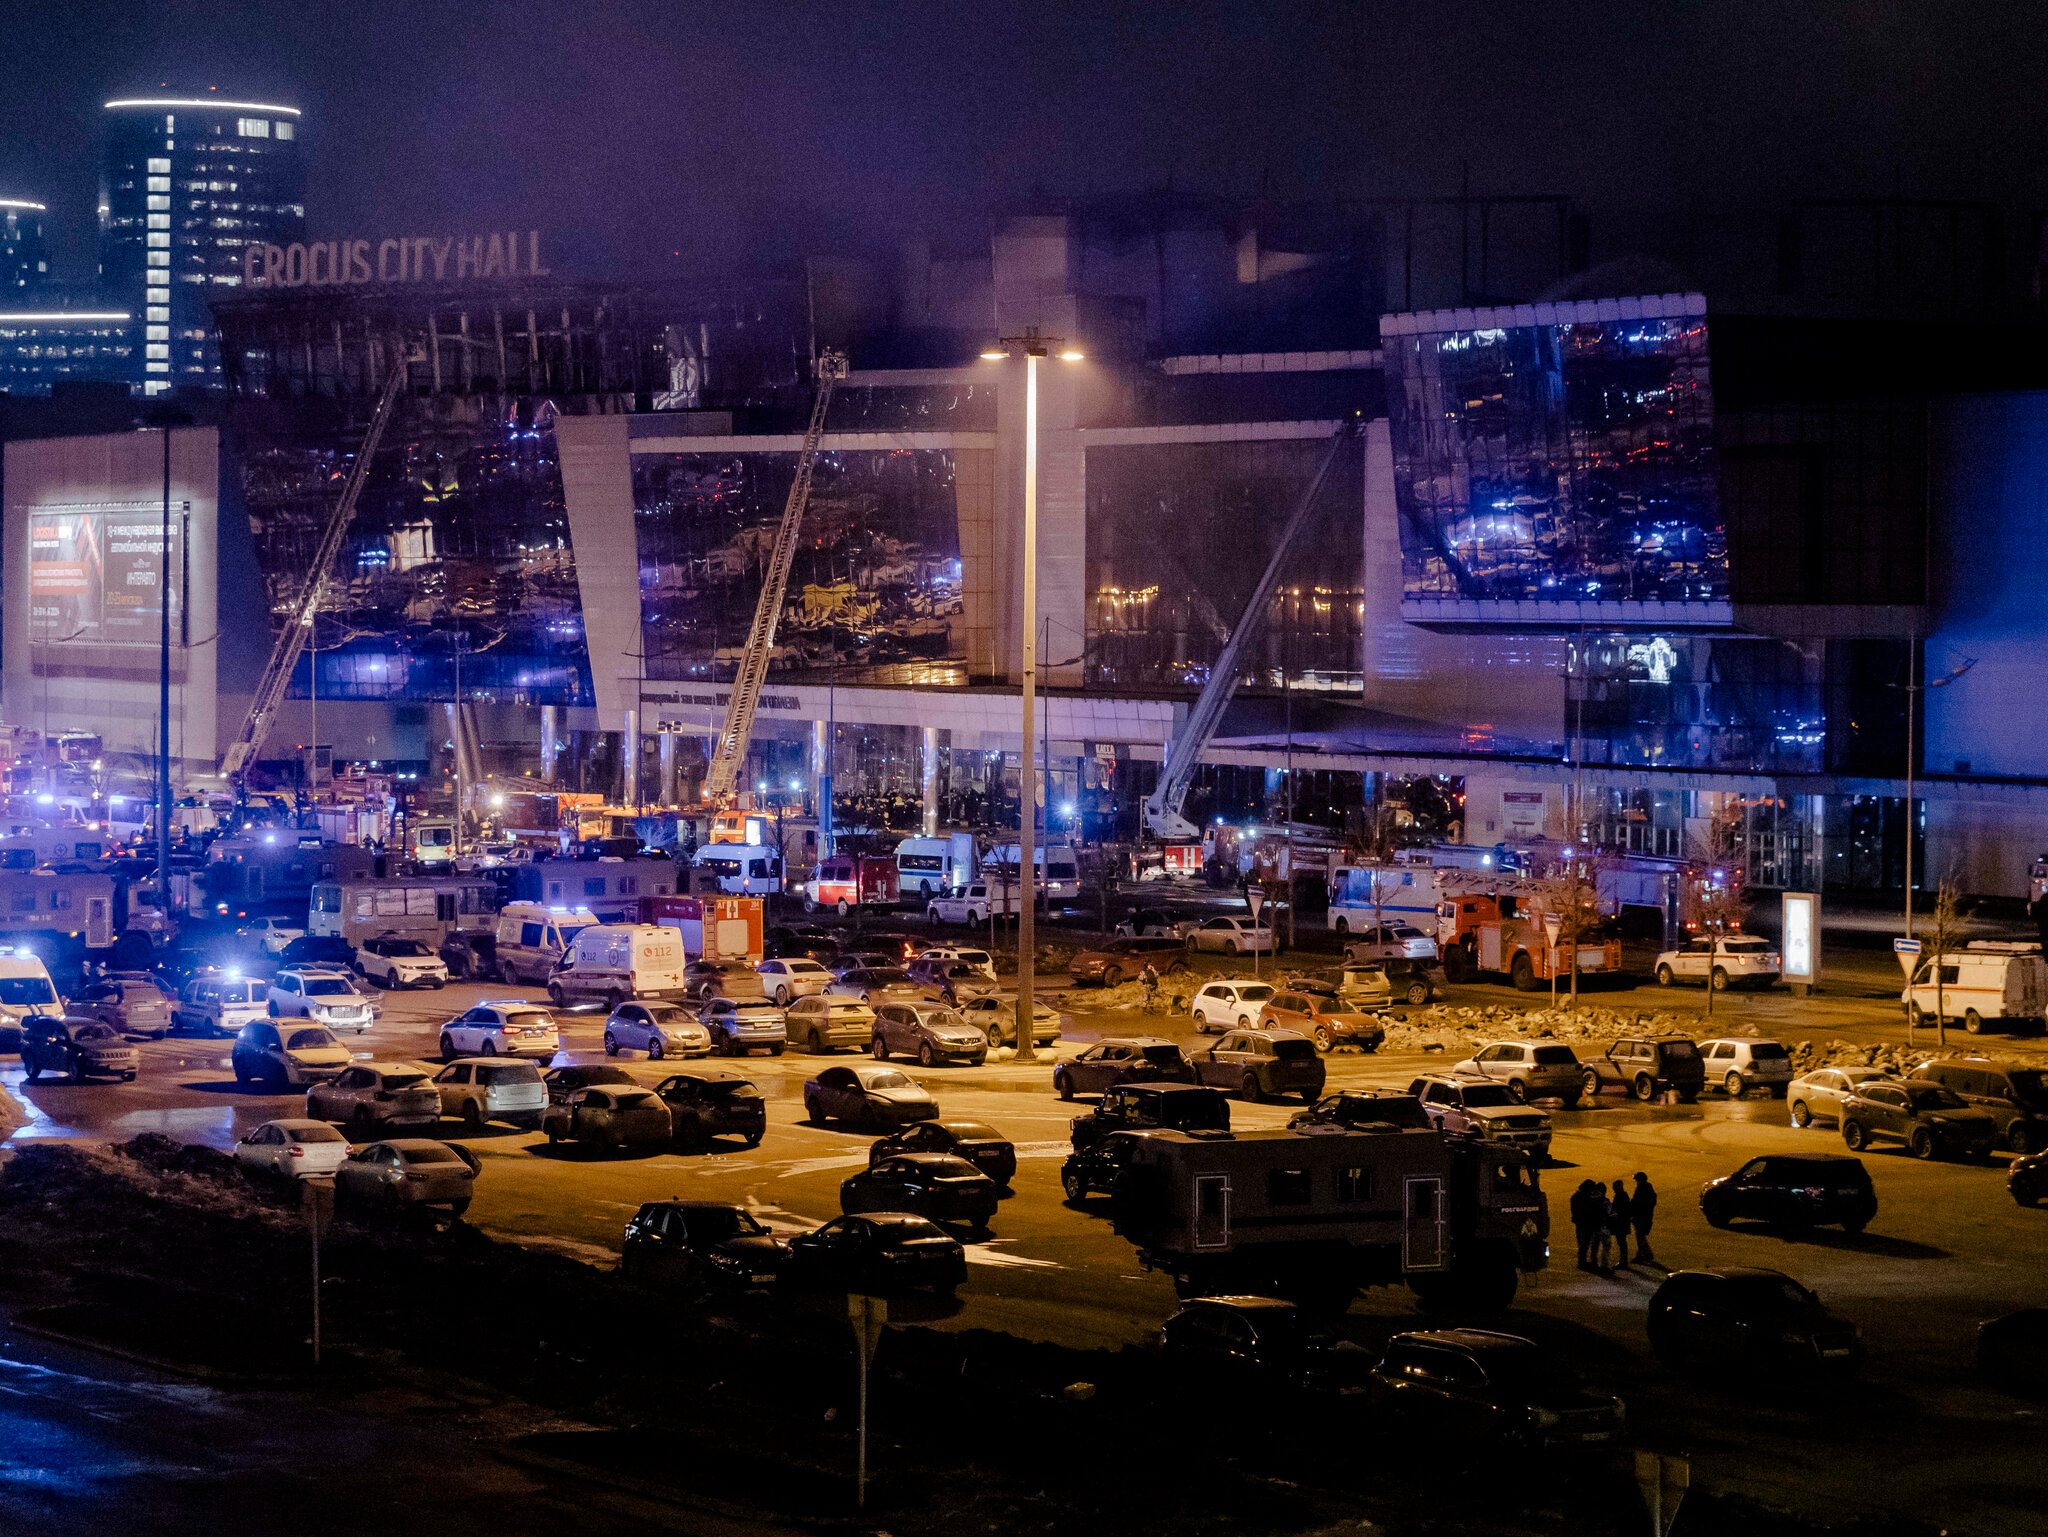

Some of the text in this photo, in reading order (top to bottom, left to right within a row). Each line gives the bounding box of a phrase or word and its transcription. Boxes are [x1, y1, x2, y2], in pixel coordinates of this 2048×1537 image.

[244, 230, 550, 288] CROCUS CITY HALL
[587, 952, 597, 961] 112
[655, 946, 672, 957] 112
